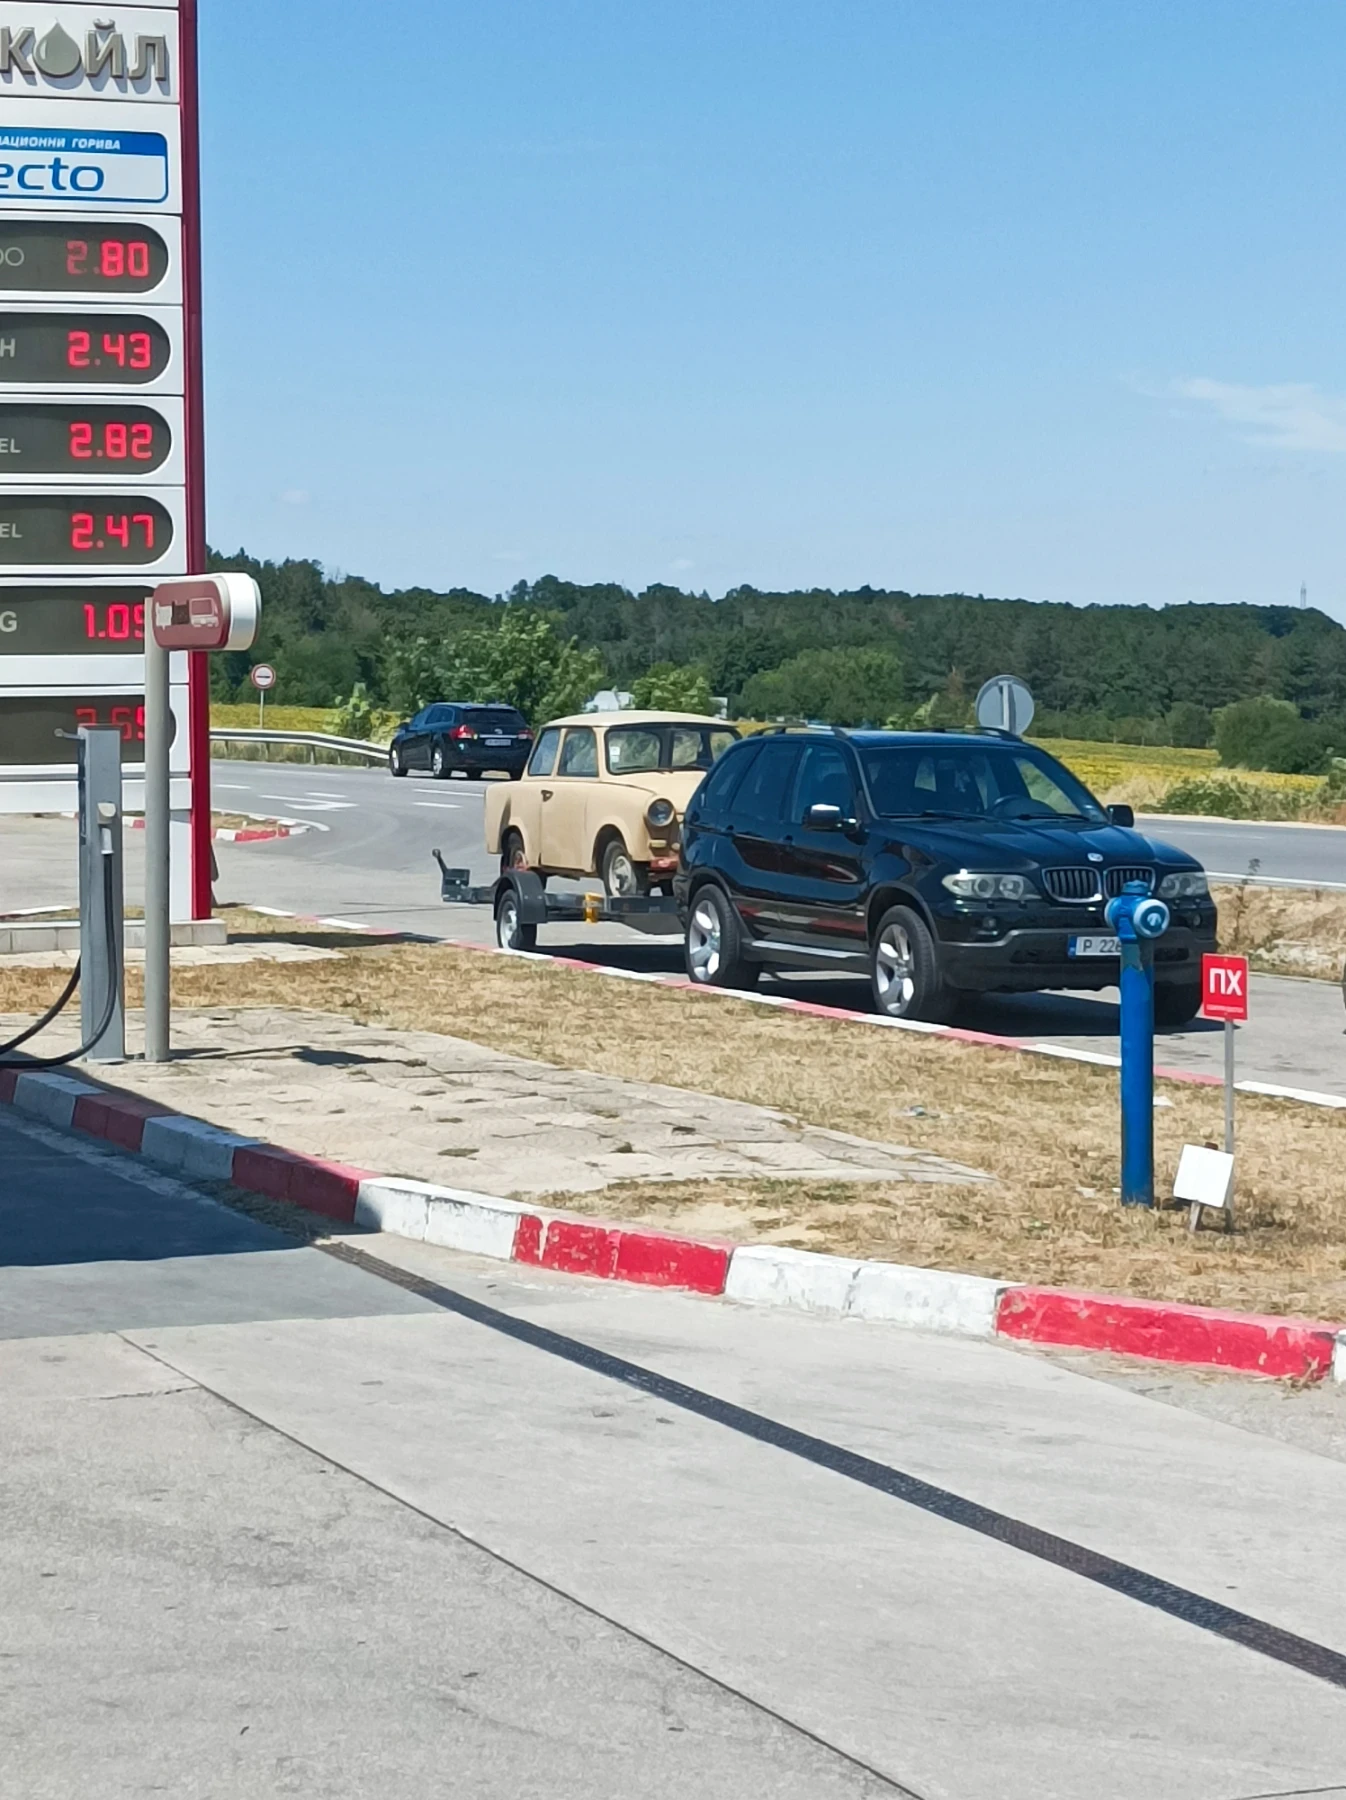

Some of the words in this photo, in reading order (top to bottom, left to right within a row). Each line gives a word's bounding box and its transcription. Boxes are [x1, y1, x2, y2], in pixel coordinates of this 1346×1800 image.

[0, 136, 65, 148] АЦИОННИ
[72, 138, 120, 149] ГОРИВА
[66, 241, 149, 277] 2.80
[68, 331, 151, 368] 2.43
[70, 423, 153, 459] 2.82
[72, 513, 154, 548] 2.47
[1209, 967, 1243, 996] ПХ
